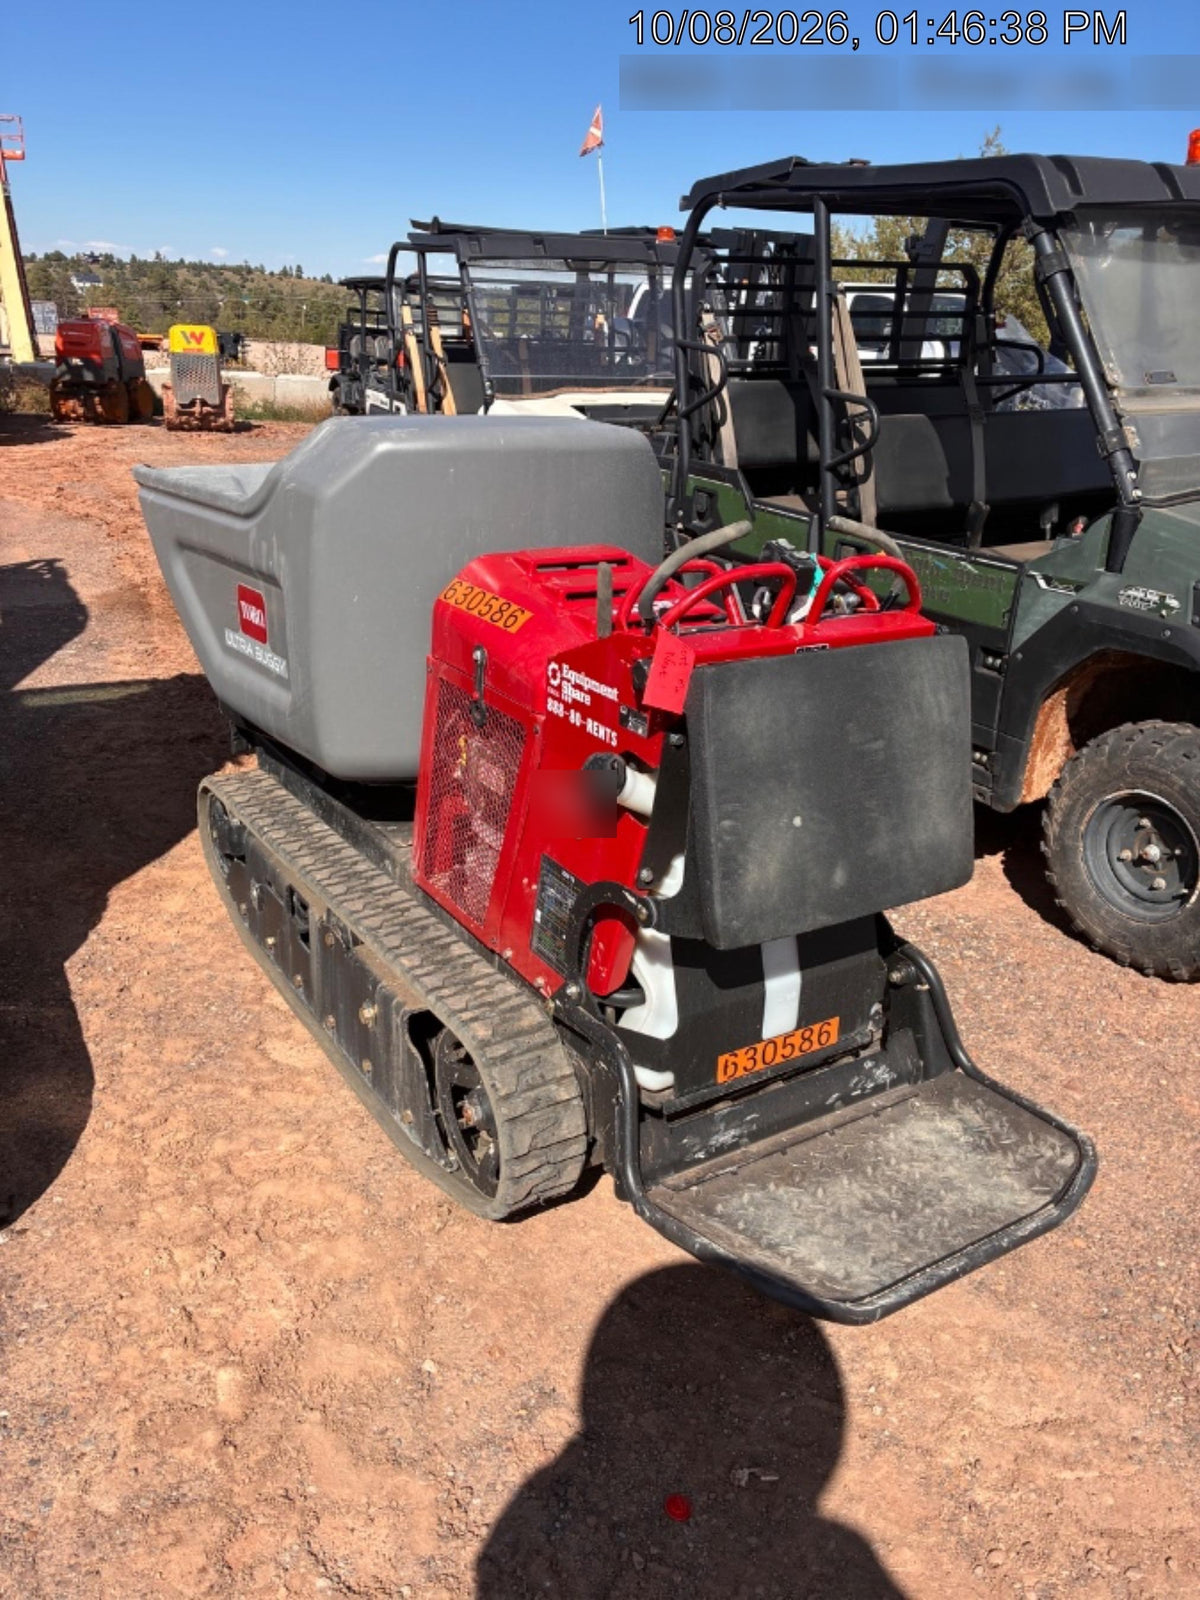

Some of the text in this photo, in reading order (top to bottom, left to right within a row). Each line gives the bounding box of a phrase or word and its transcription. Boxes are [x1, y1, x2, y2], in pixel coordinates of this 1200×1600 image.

[443, 581, 525, 628] 630586
[561, 680, 591, 706] Share
[562, 663, 619, 702] Equipment
[723, 1022, 831, 1079] 630586
